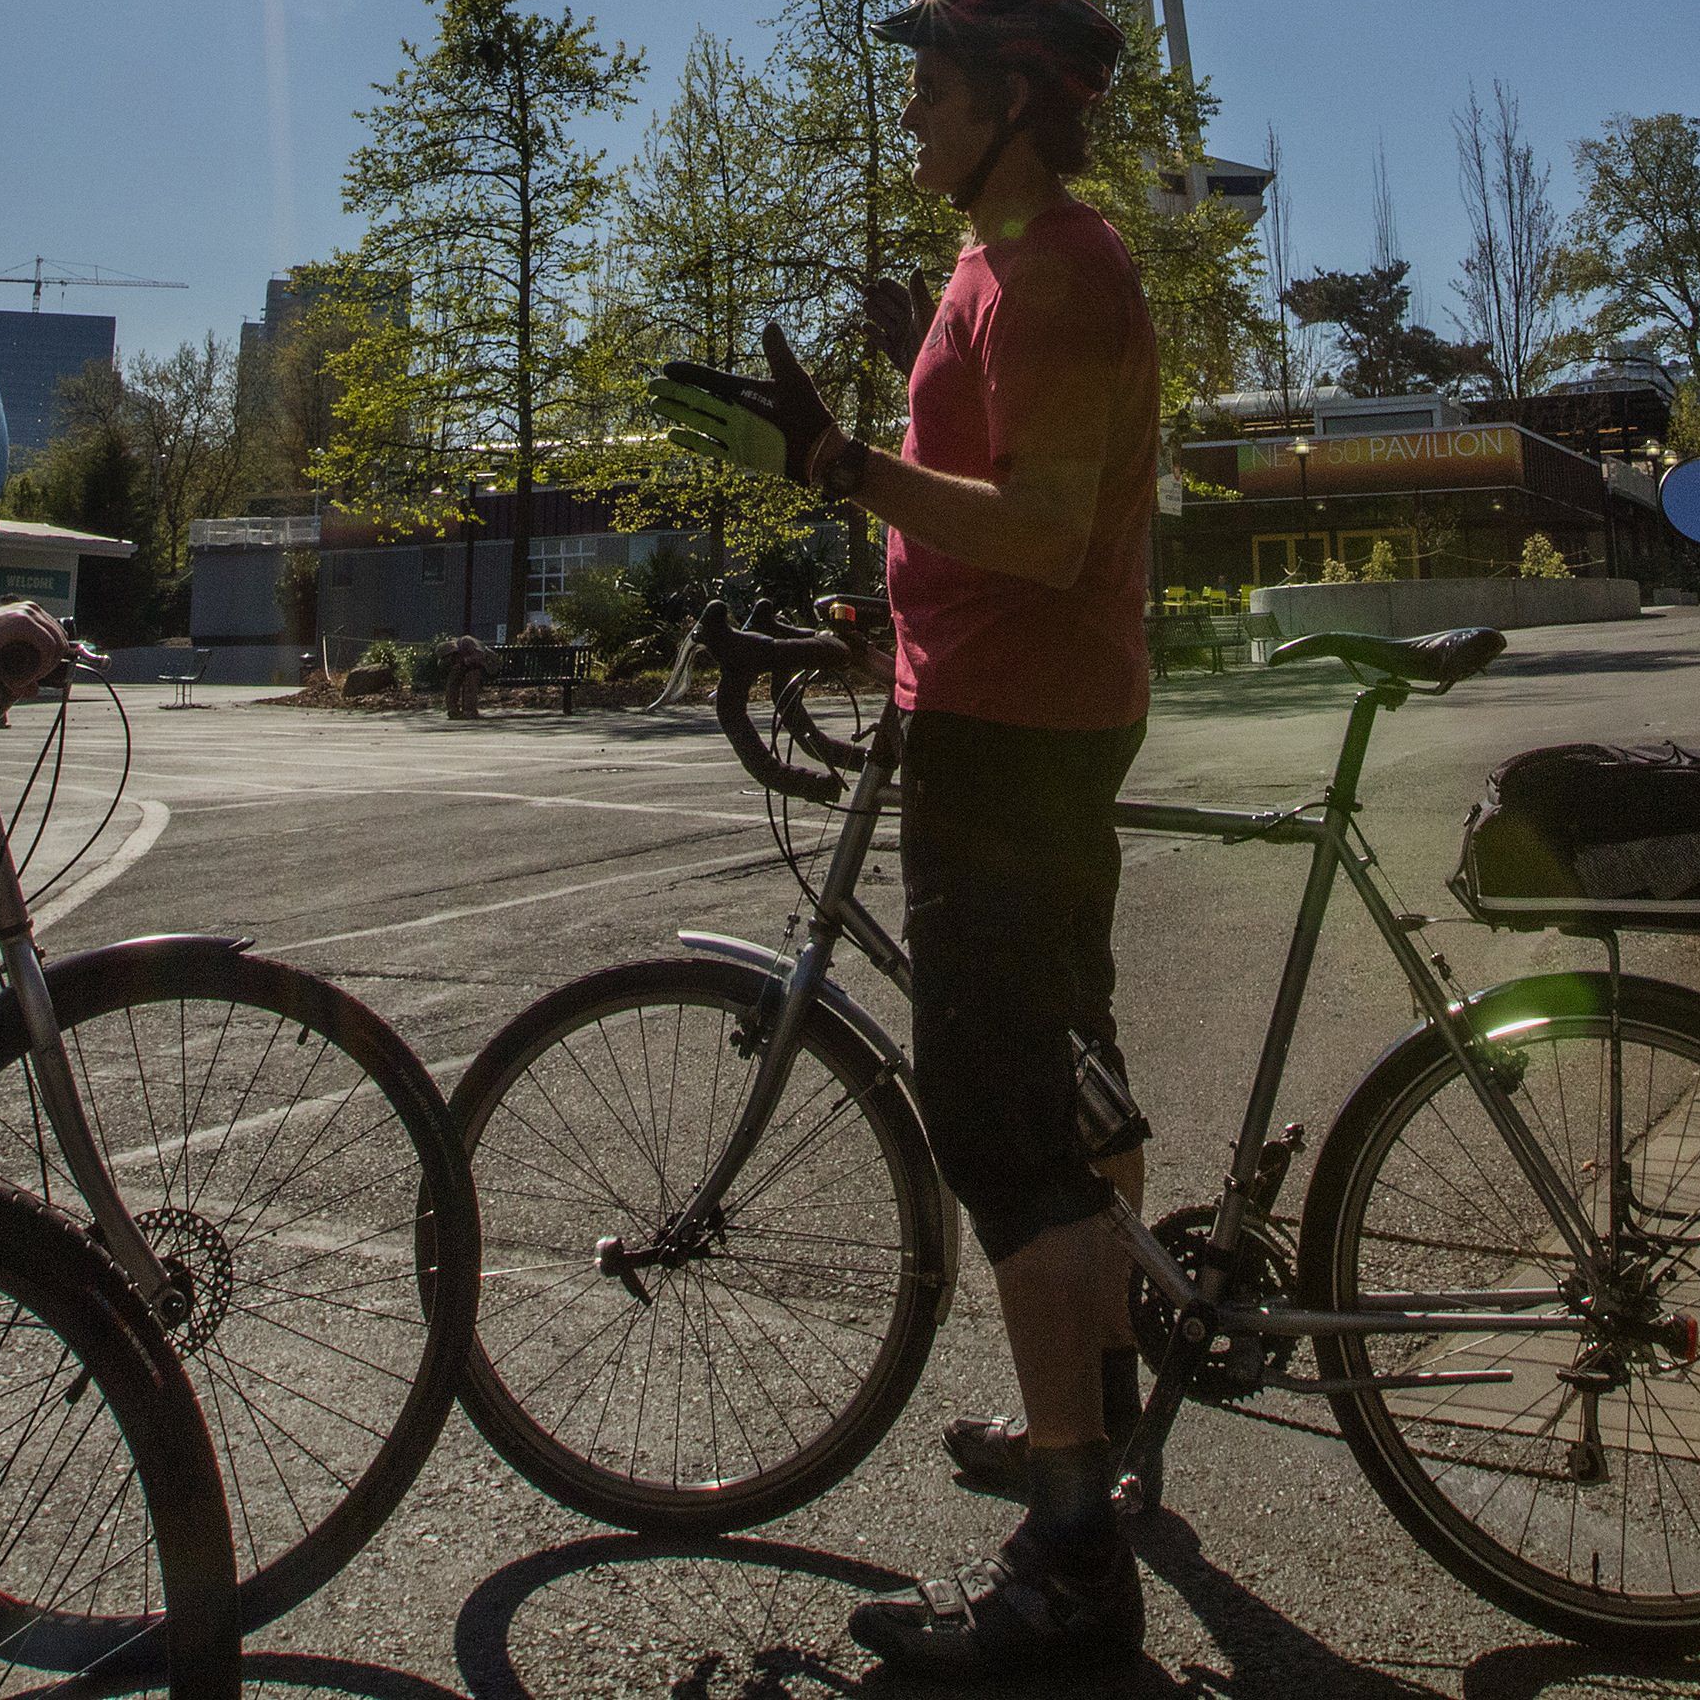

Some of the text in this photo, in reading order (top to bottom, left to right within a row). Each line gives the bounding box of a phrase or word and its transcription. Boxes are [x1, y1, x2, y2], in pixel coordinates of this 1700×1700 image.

[740, 389, 774, 409] HESTRA
[1327, 438, 1361, 465] 50
[1369, 430, 1504, 462] PAVILION
[6, 574, 55, 590] WELCOME
